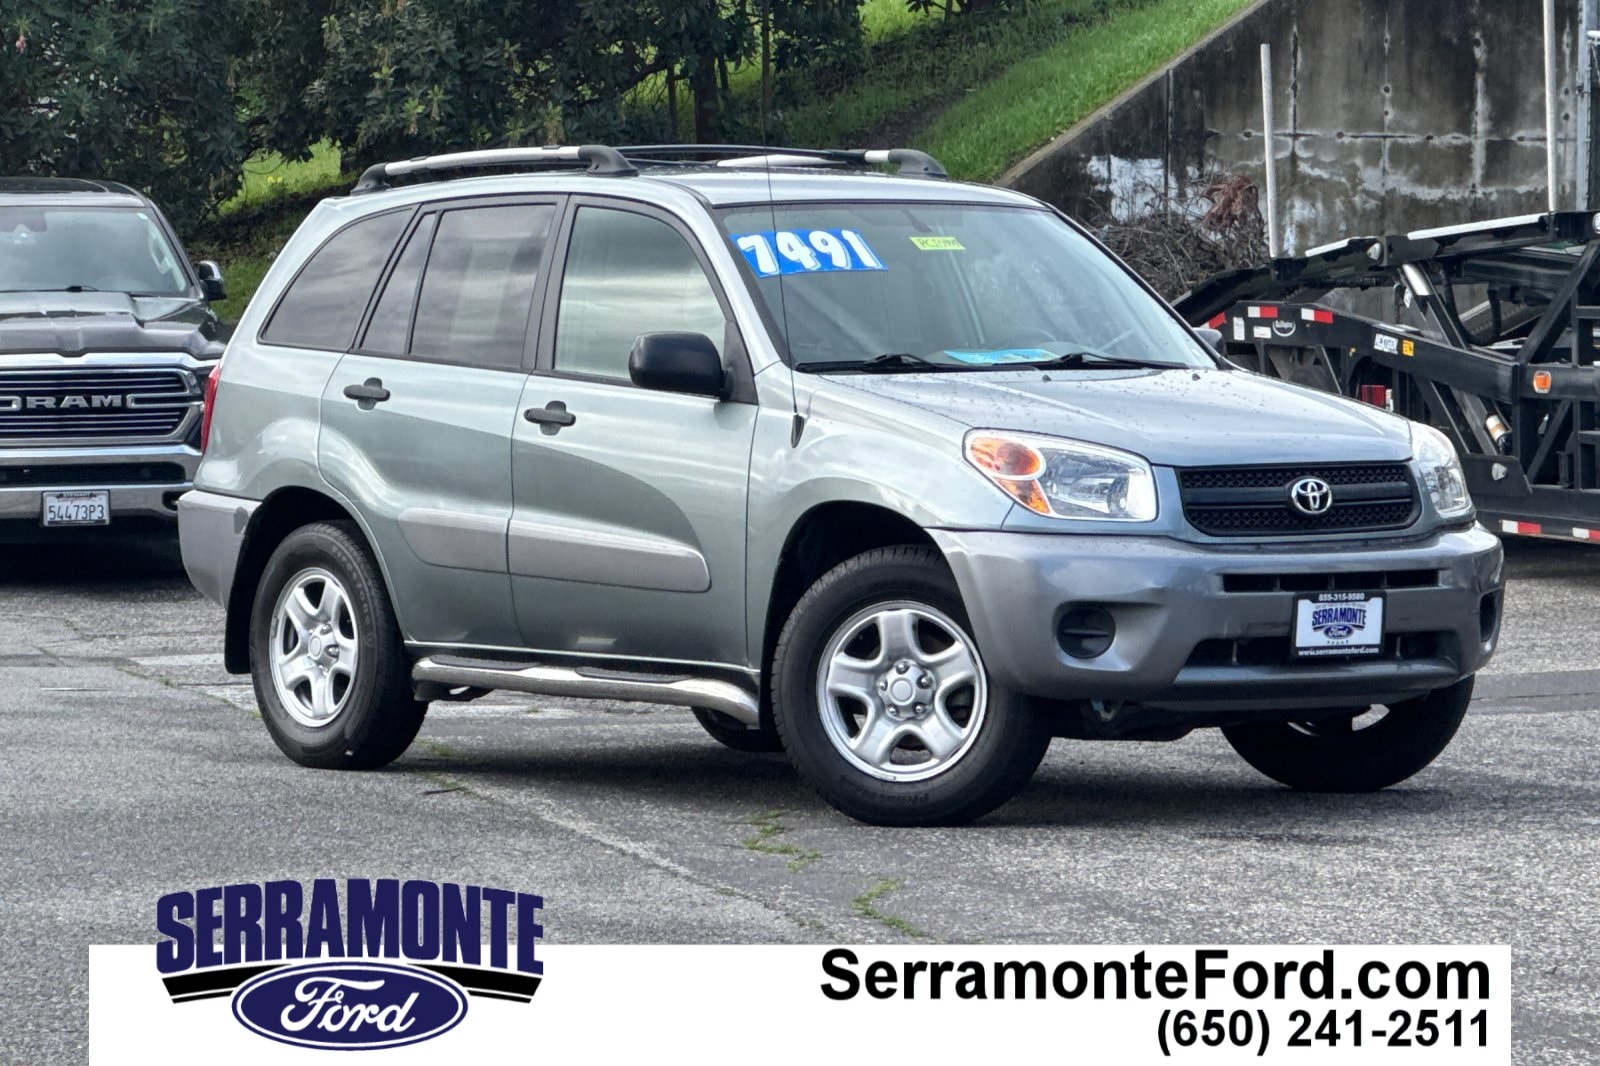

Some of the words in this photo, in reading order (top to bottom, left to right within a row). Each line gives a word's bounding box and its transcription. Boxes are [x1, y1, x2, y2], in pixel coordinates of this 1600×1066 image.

[736, 229, 882, 274] 7491
[26, 395, 122, 408] RAM
[48, 504, 104, 521] 54473P3
[1312, 607, 1367, 626] SERRAMONTE
[1328, 625, 1349, 637] Ford
